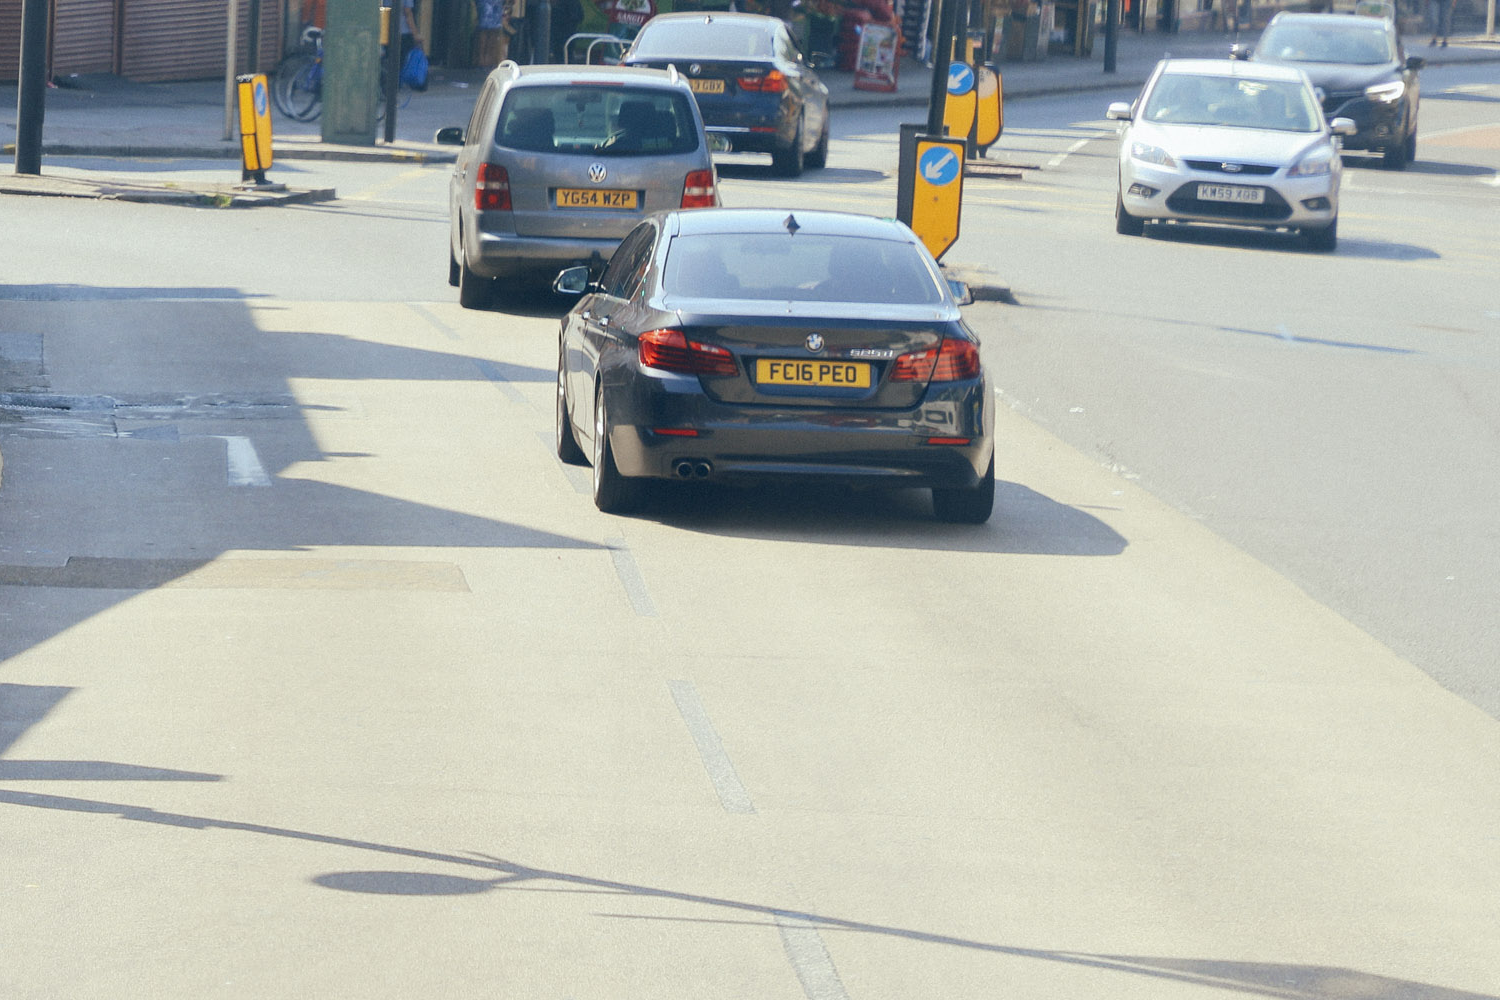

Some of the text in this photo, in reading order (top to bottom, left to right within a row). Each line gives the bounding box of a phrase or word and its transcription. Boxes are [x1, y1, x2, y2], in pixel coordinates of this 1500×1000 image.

[562, 191, 631, 206] YG54 WZP
[770, 362, 857, 384] FC16 PEO
